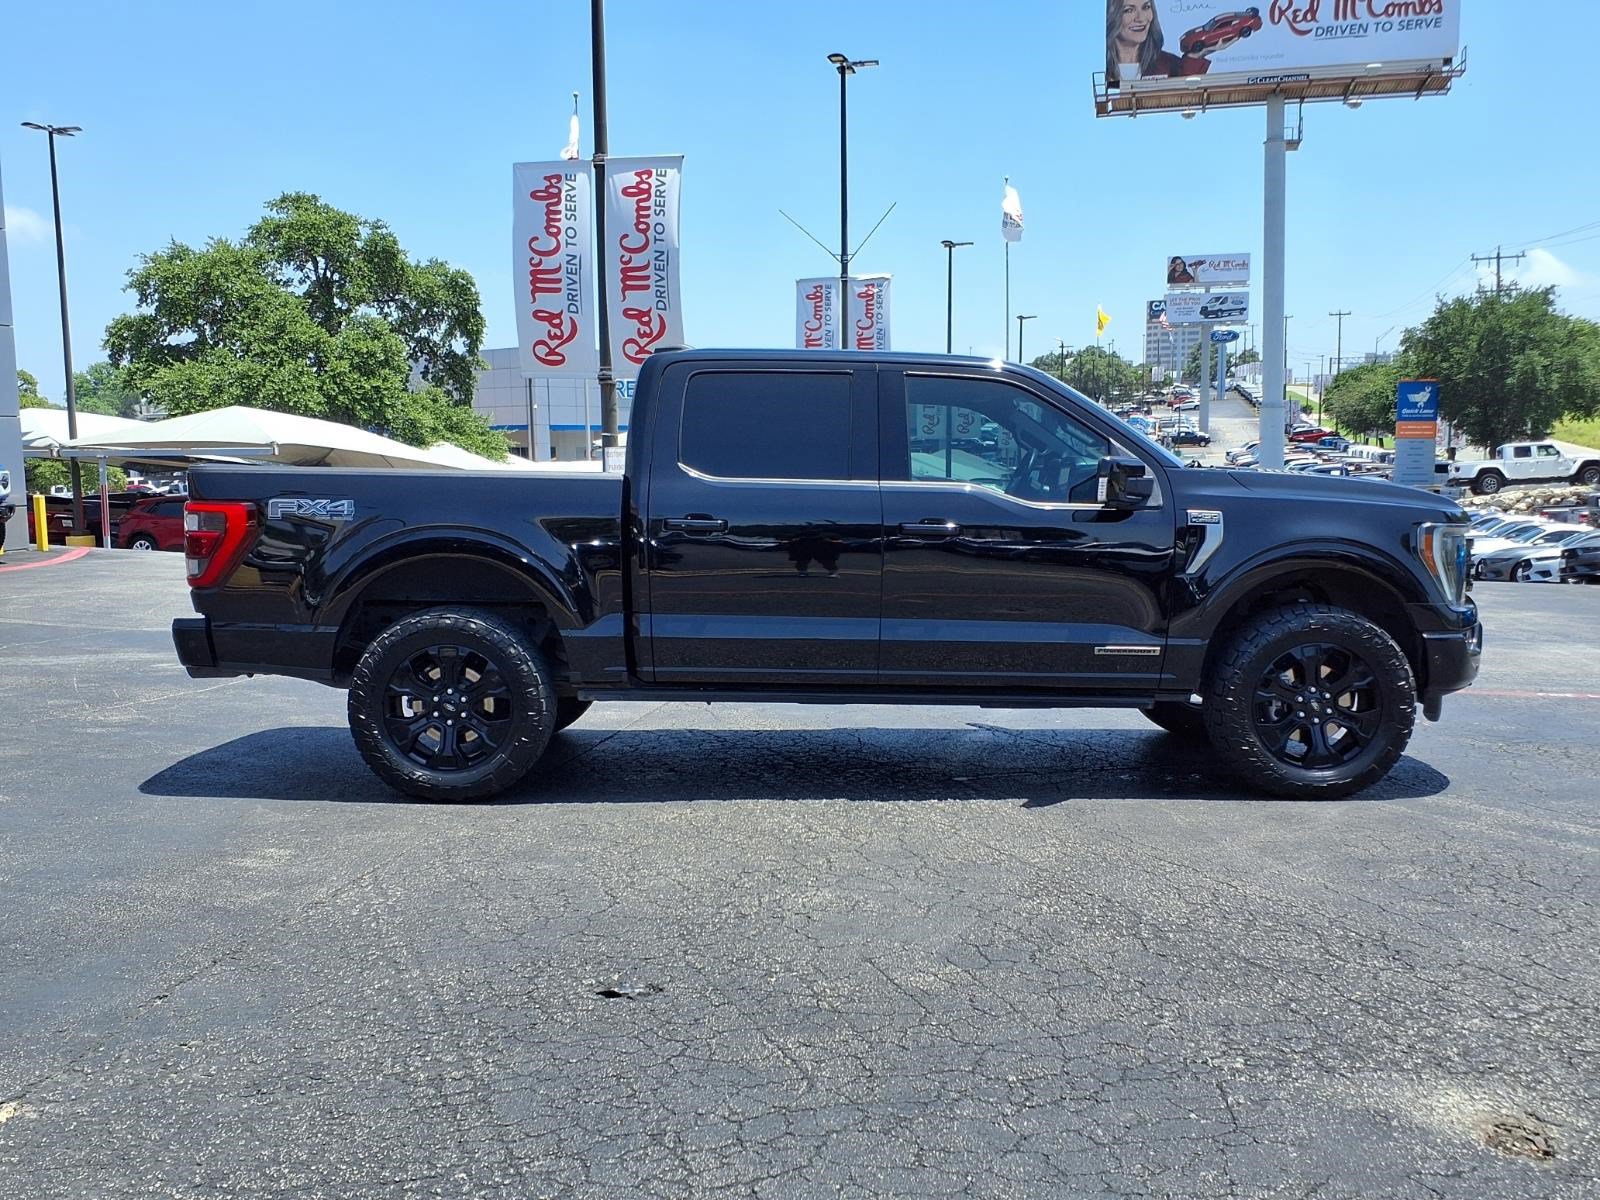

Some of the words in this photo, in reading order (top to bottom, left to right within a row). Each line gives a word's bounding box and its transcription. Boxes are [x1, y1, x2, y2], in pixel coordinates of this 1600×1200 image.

[1334, 0, 1443, 21] MCombs
[1314, 23, 1369, 38] DRIVEN
[1375, 21, 1393, 33] TO
[1397, 17, 1443, 31] SERVE
[565, 173, 577, 222] SERVE
[654, 168, 667, 218] SERVE
[528, 173, 563, 304] McCombs
[565, 226, 578, 248] TO
[619, 168, 653, 303] McCombs
[654, 222, 665, 245] TO
[565, 253, 580, 315] DRIVEN
[654, 249, 668, 312] DRIVEN
[824, 284, 832, 312] SERVE
[876, 282, 884, 311] SERVE
[824, 314, 832, 326] TO
[876, 312, 884, 325] TO
[532, 308, 578, 367] Red
[622, 307, 667, 365] Red
[268, 498, 355, 520] FX4
